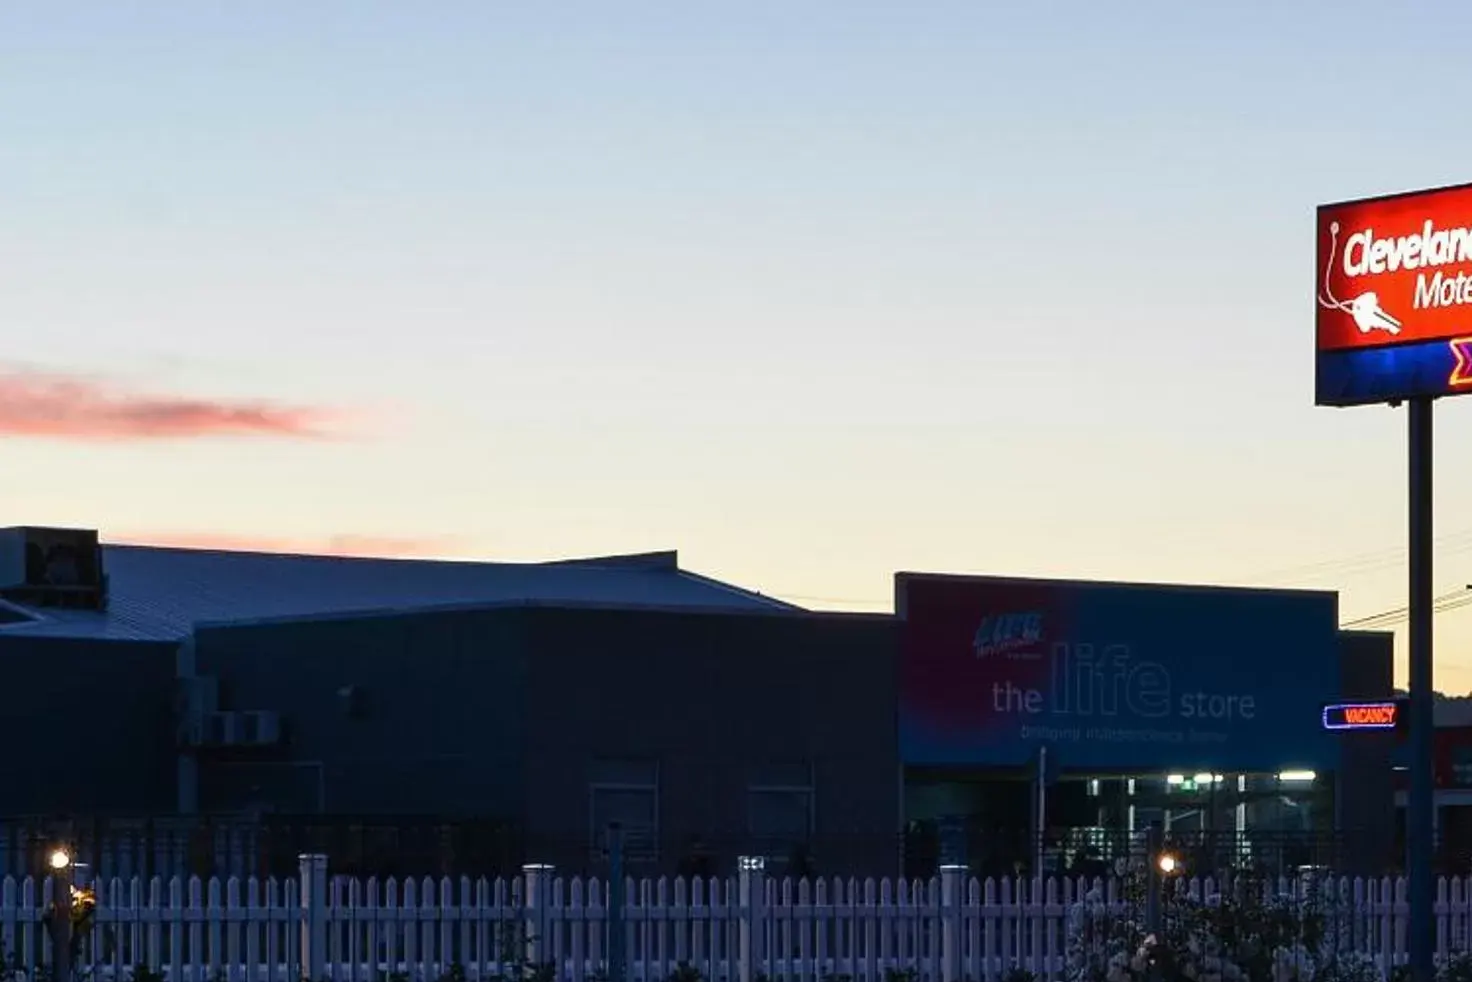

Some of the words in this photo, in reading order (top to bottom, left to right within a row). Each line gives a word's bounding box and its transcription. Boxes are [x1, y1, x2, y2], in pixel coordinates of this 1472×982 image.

[991, 680, 1044, 713] the
[1051, 641, 1173, 718] life
[1179, 689, 1257, 720] store
[1345, 707, 1396, 723] VACANCY
